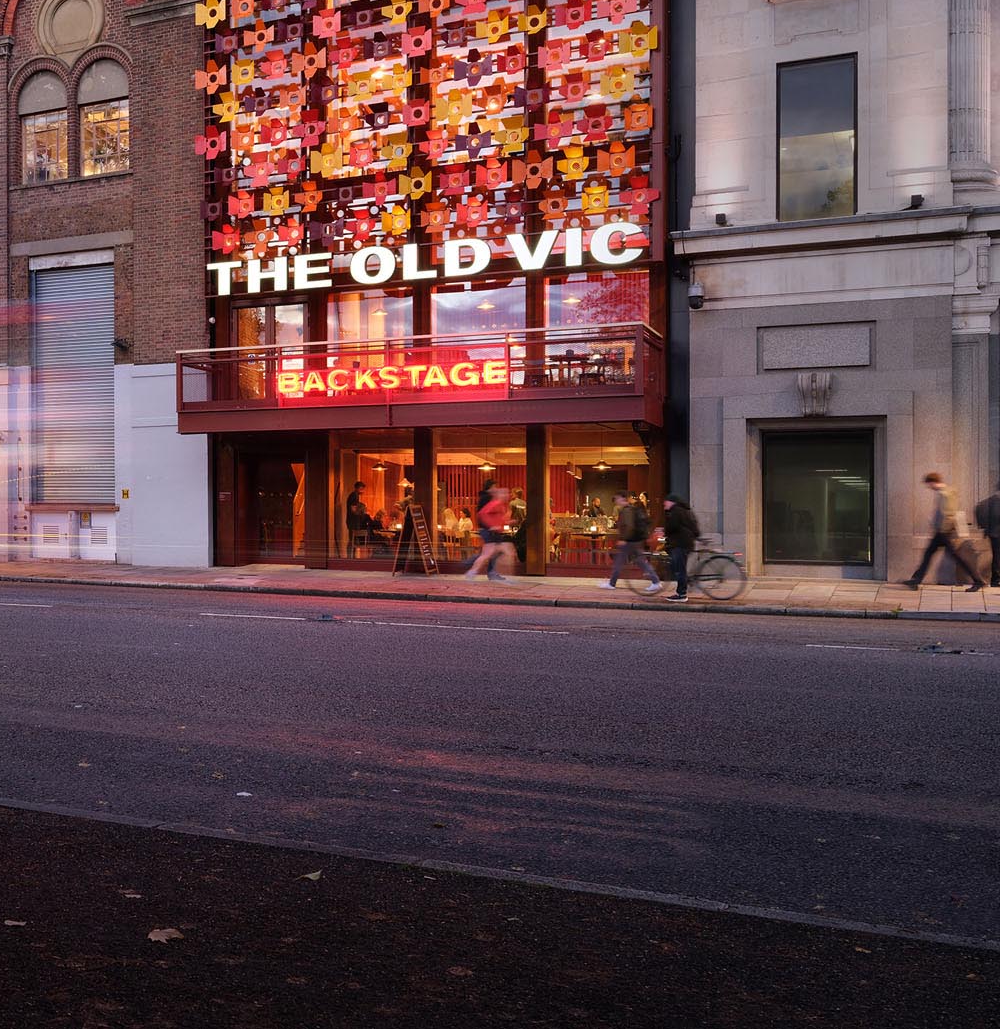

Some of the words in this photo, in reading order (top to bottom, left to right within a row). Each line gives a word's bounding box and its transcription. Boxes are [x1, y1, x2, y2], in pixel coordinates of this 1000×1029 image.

[206, 252, 333, 296] THE
[350, 238, 492, 285] OLD
[506, 221, 644, 271] VIC
[278, 360, 508, 393] BACKSTAGE
